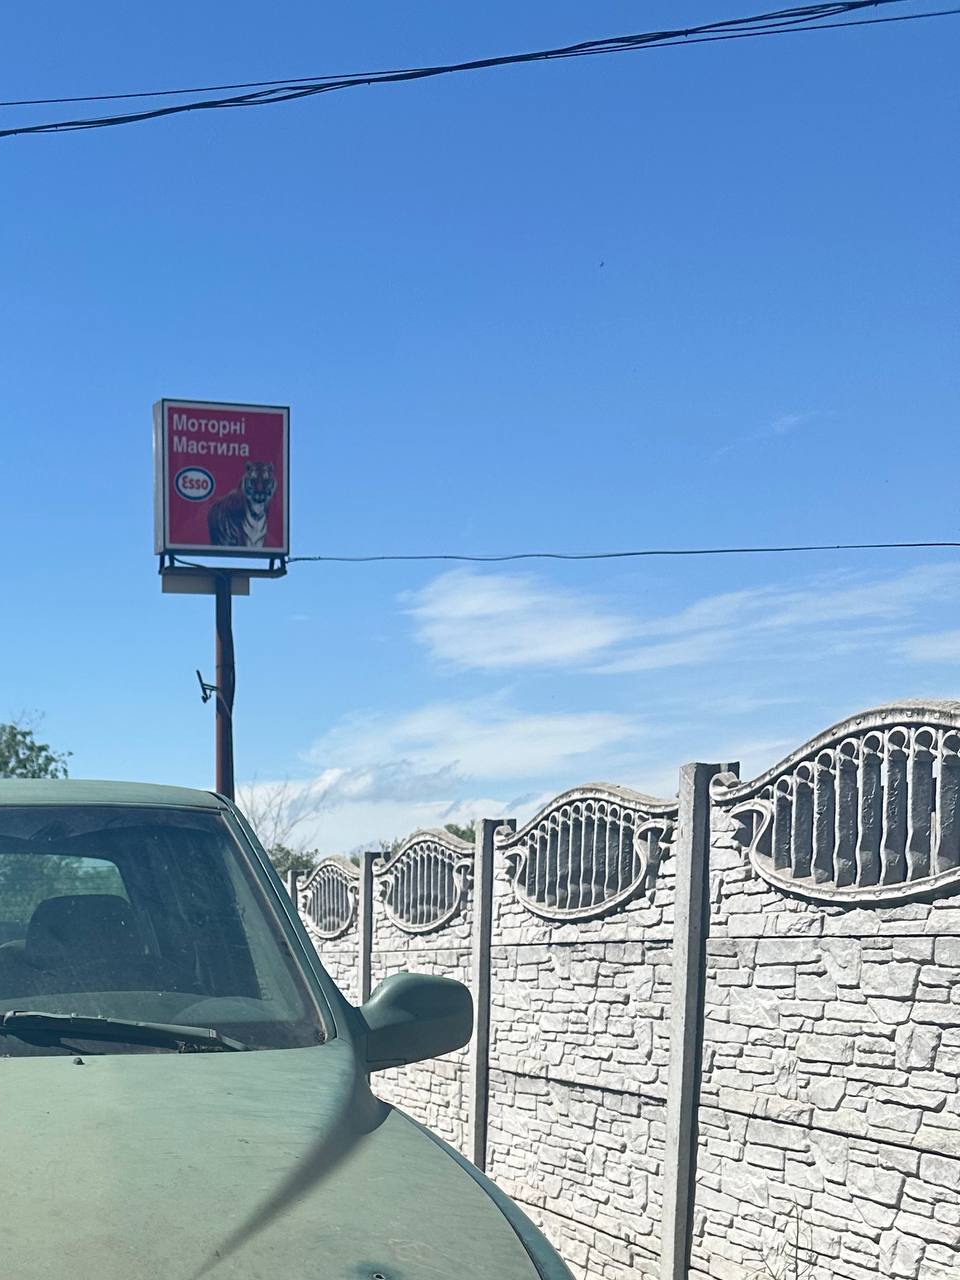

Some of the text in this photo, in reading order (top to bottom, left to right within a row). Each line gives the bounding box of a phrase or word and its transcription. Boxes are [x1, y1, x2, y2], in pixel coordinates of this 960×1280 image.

[173, 414, 245, 437] Моторні
[173, 436, 249, 456] Мастила
[182, 475, 209, 490] Esso
